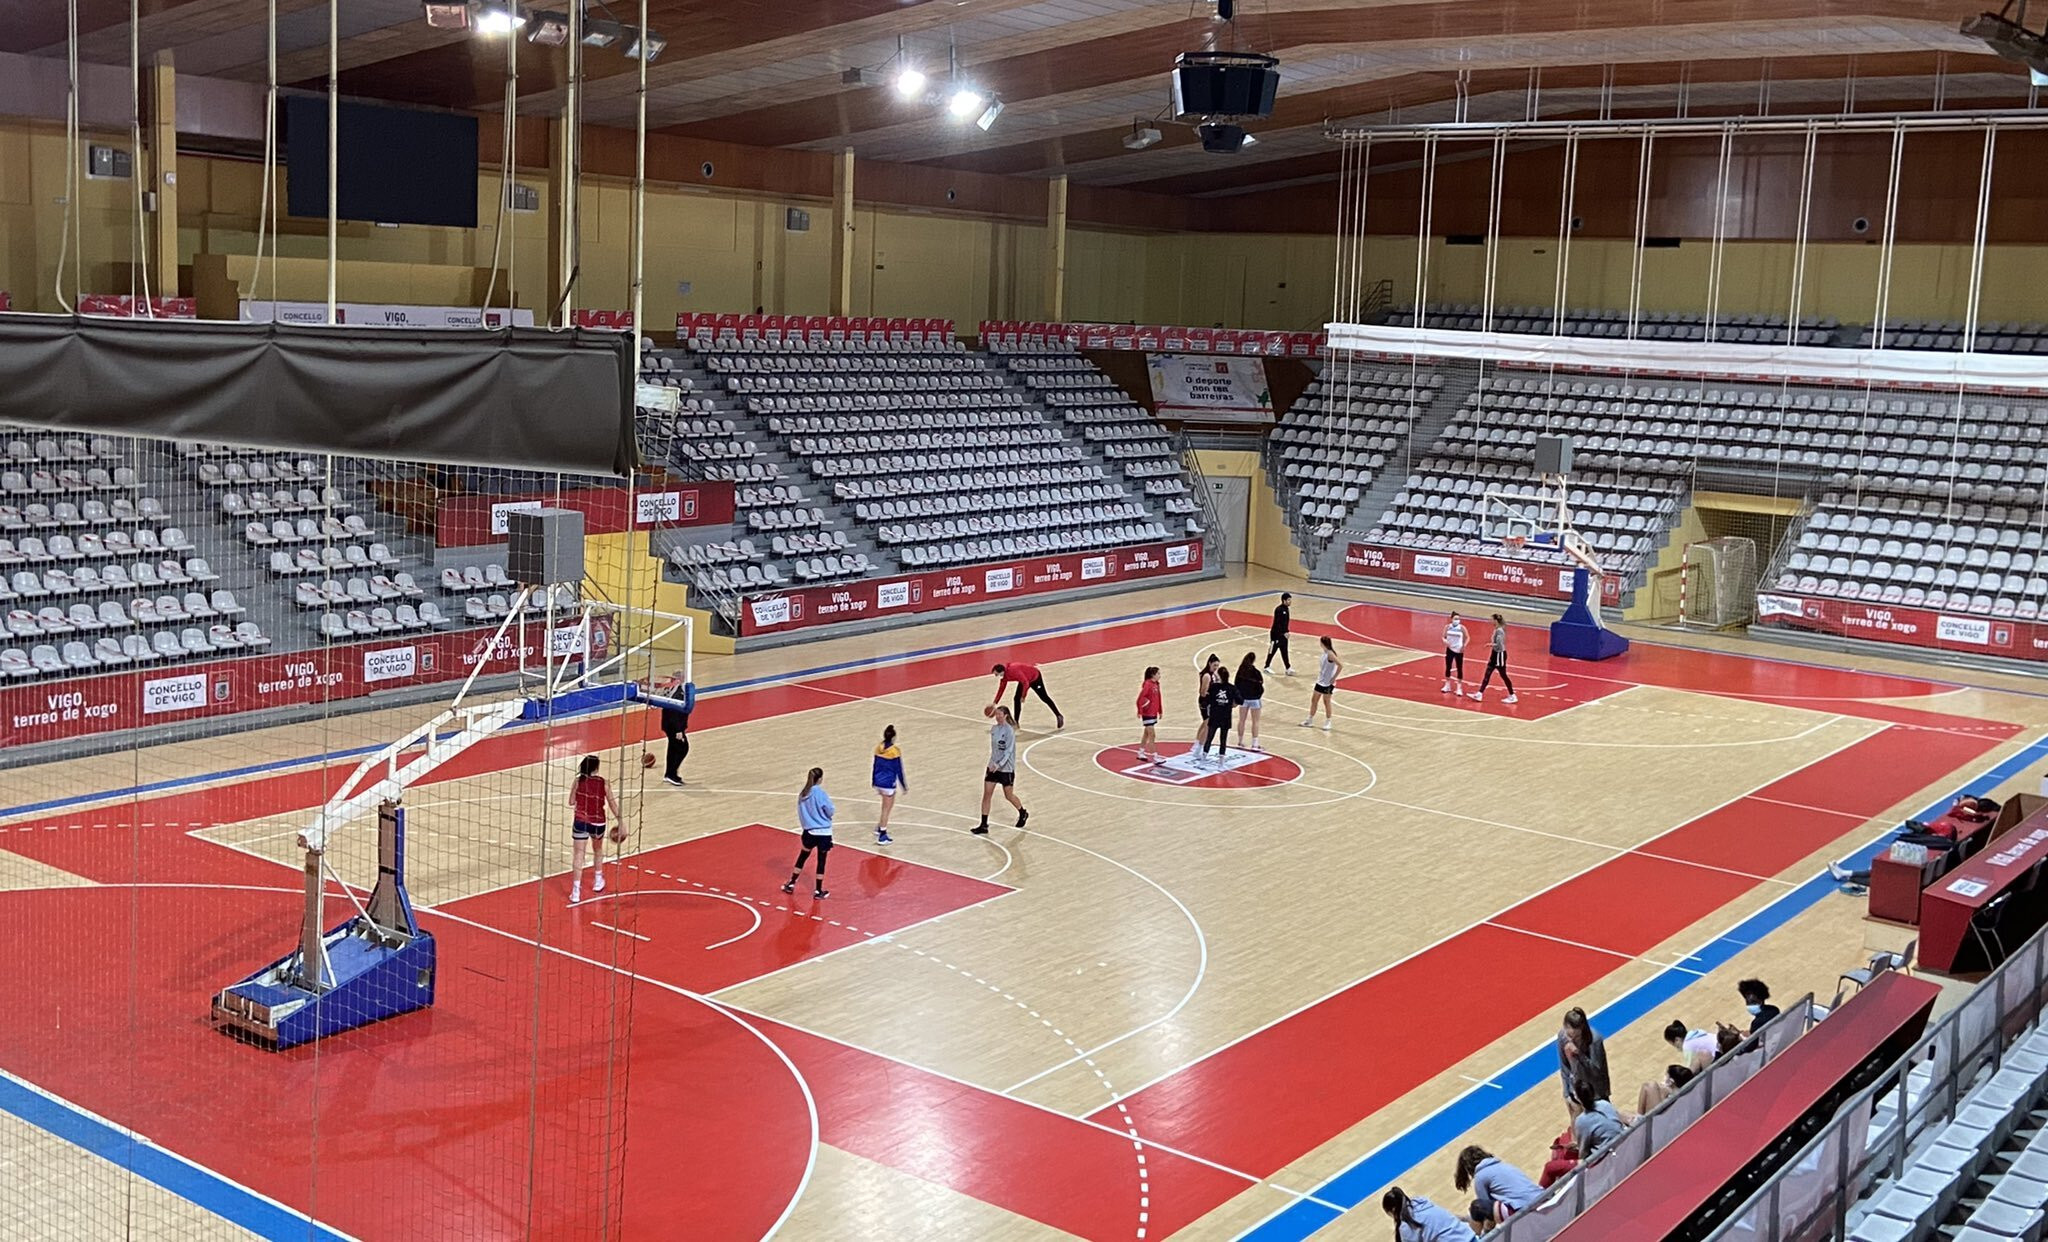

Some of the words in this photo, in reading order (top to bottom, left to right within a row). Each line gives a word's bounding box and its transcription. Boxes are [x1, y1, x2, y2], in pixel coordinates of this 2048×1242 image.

[283, 312, 322, 320] CONCELLO
[385, 311, 409, 323] VIGO,
[448, 316, 481, 324] CONCELLO
[1185, 376, 1192, 384] O
[1195, 376, 1231, 386] deporte
[1190, 391, 1234, 401] barreiras
[640, 498, 676, 507] CONCELLO
[644, 508, 653, 516] DE
[1363, 549, 1385, 561] VIGO,
[1370, 559, 1380, 568] de
[1382, 560, 1400, 571] xogo
[1417, 559, 1449, 568] CONCELLO
[1502, 564, 1526, 576] VIGO,
[1483, 571, 1508, 582] terreo
[1510, 575, 1520, 584] de
[1523, 576, 1543, 587] xogo
[879, 586, 907, 596] CONCELLO
[831, 592, 852, 603] VIGO,
[891, 594, 904, 602] VIGO
[839, 602, 849, 612] de
[1866, 608, 1894, 621] VIGO,
[1842, 615, 1872, 628] terreo
[1875, 619, 1888, 629] de
[1891, 622, 1917, 634] xogo
[1940, 620, 1985, 632] CONCELLO
[1959, 630, 1979, 639] VIGO
[368, 652, 412, 667] CONCELLO
[496, 648, 509, 660] de
[285, 661, 319, 677] VIGO,
[373, 666, 385, 675] DE
[387, 663, 407, 673] VIGO
[149, 681, 202, 696] CONCELLO
[258, 678, 294, 694] terreo
[298, 675, 312, 687] de
[316, 671, 343, 687] xogo
[47, 692, 87, 710] VIGO,
[155, 695, 170, 705] DE
[172, 692, 196, 703] VIGO
[13, 710, 58, 728] terreo
[62, 706, 80, 721] de
[84, 703, 118, 718] xogo
